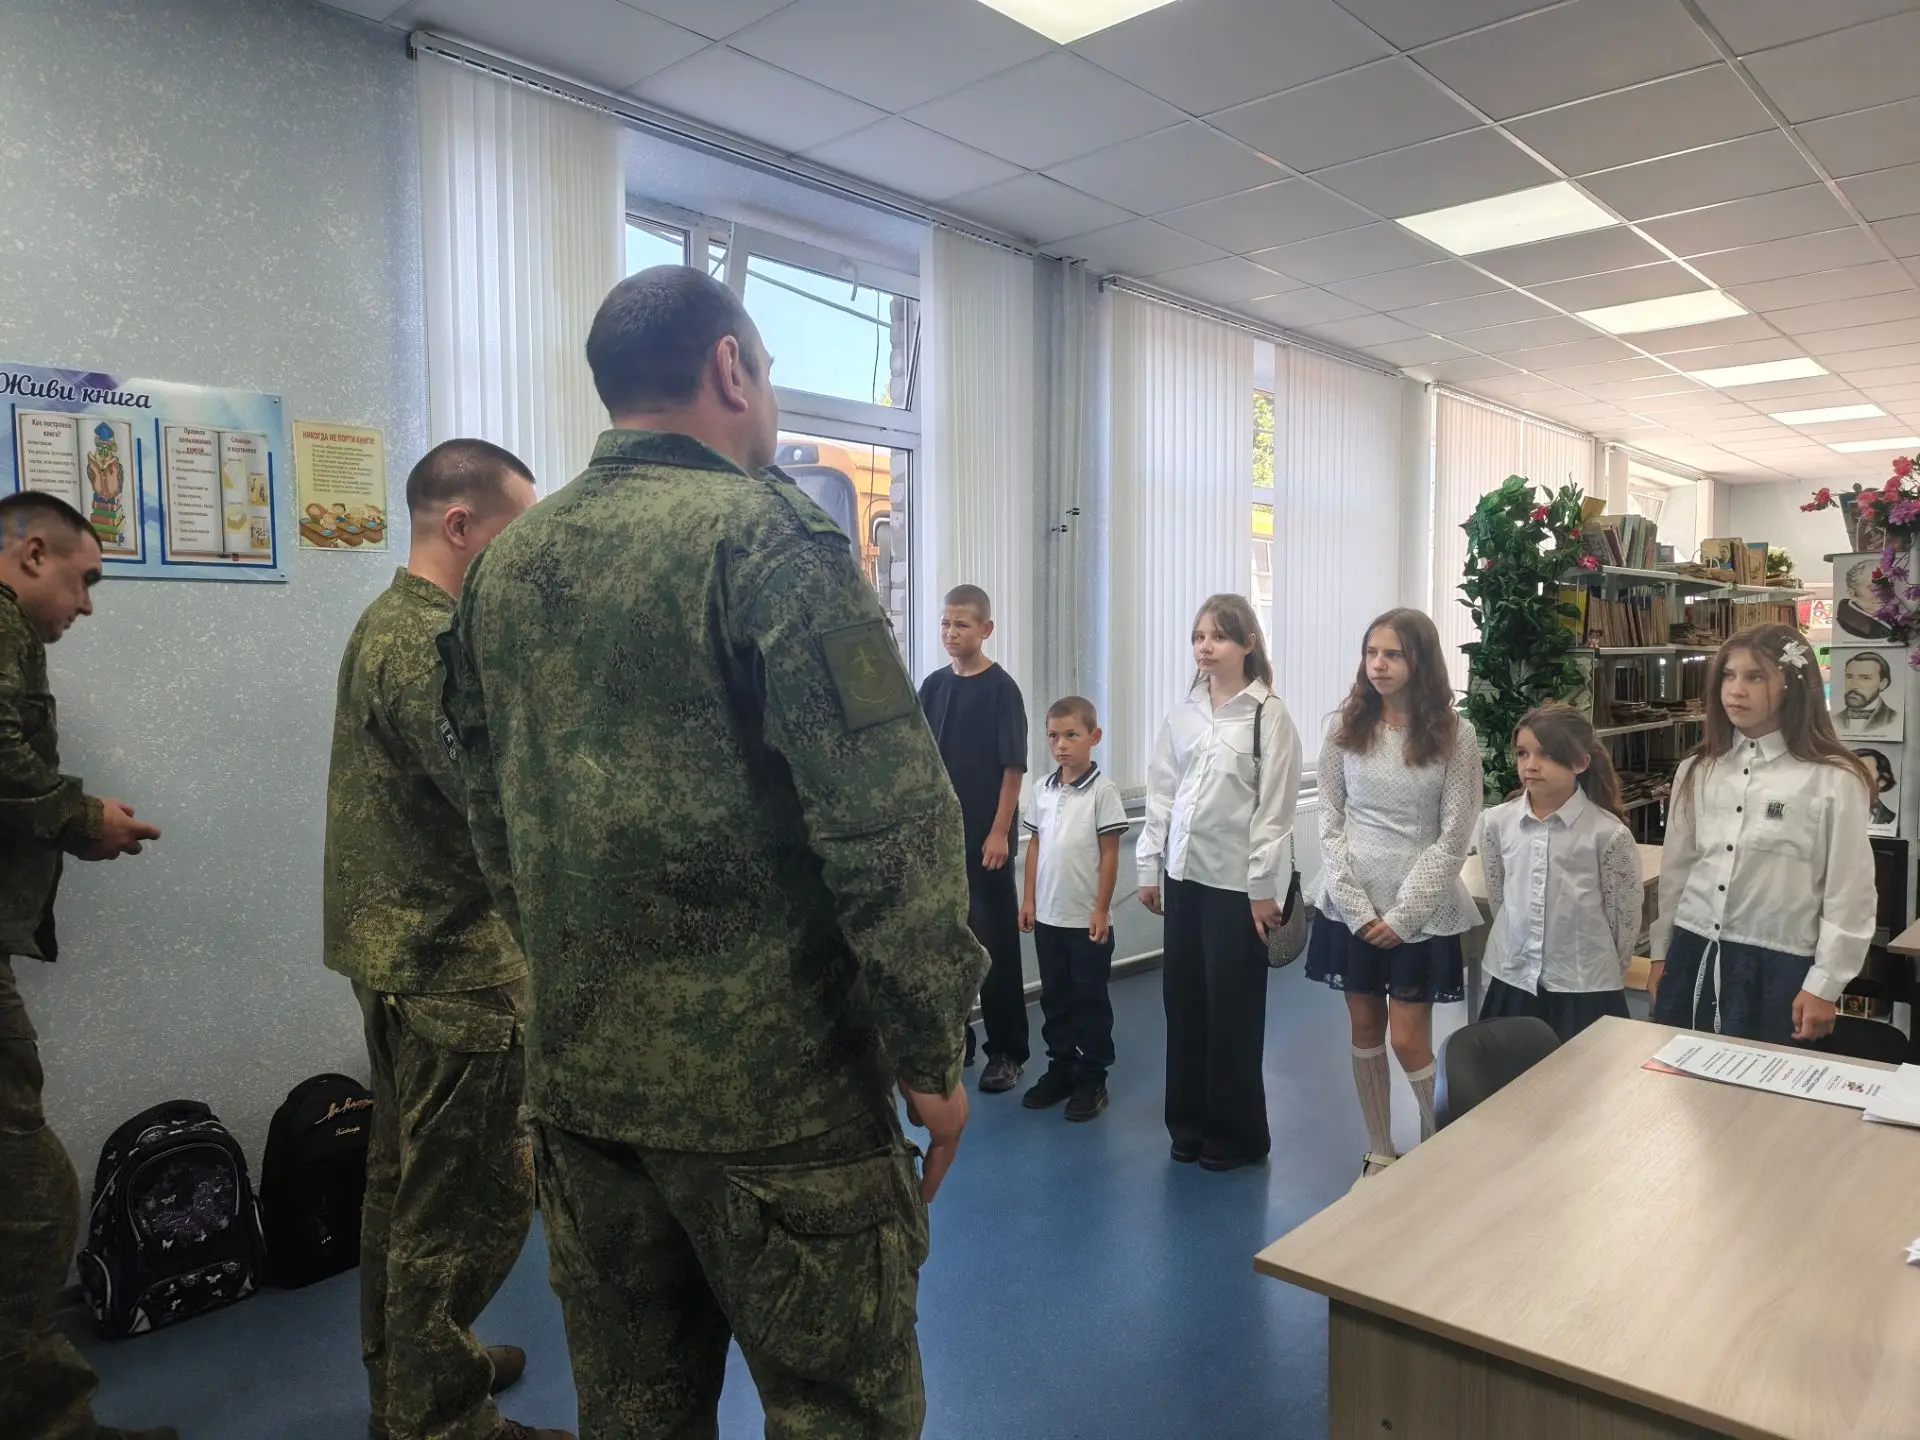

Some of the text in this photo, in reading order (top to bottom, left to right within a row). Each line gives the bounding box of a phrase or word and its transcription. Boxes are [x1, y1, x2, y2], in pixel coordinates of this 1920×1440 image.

[0, 372, 152, 409] Живи книга
[183, 427, 206, 436] Правила
[230, 436, 252, 445] Словарь
[302, 431, 328, 441] НИКОГДА
[330, 434, 337, 442] НЕ
[337, 434, 356, 444] ПОРТИ
[1768, 801, 1785, 810] STAY
[1767, 809, 1784, 818] REAL
